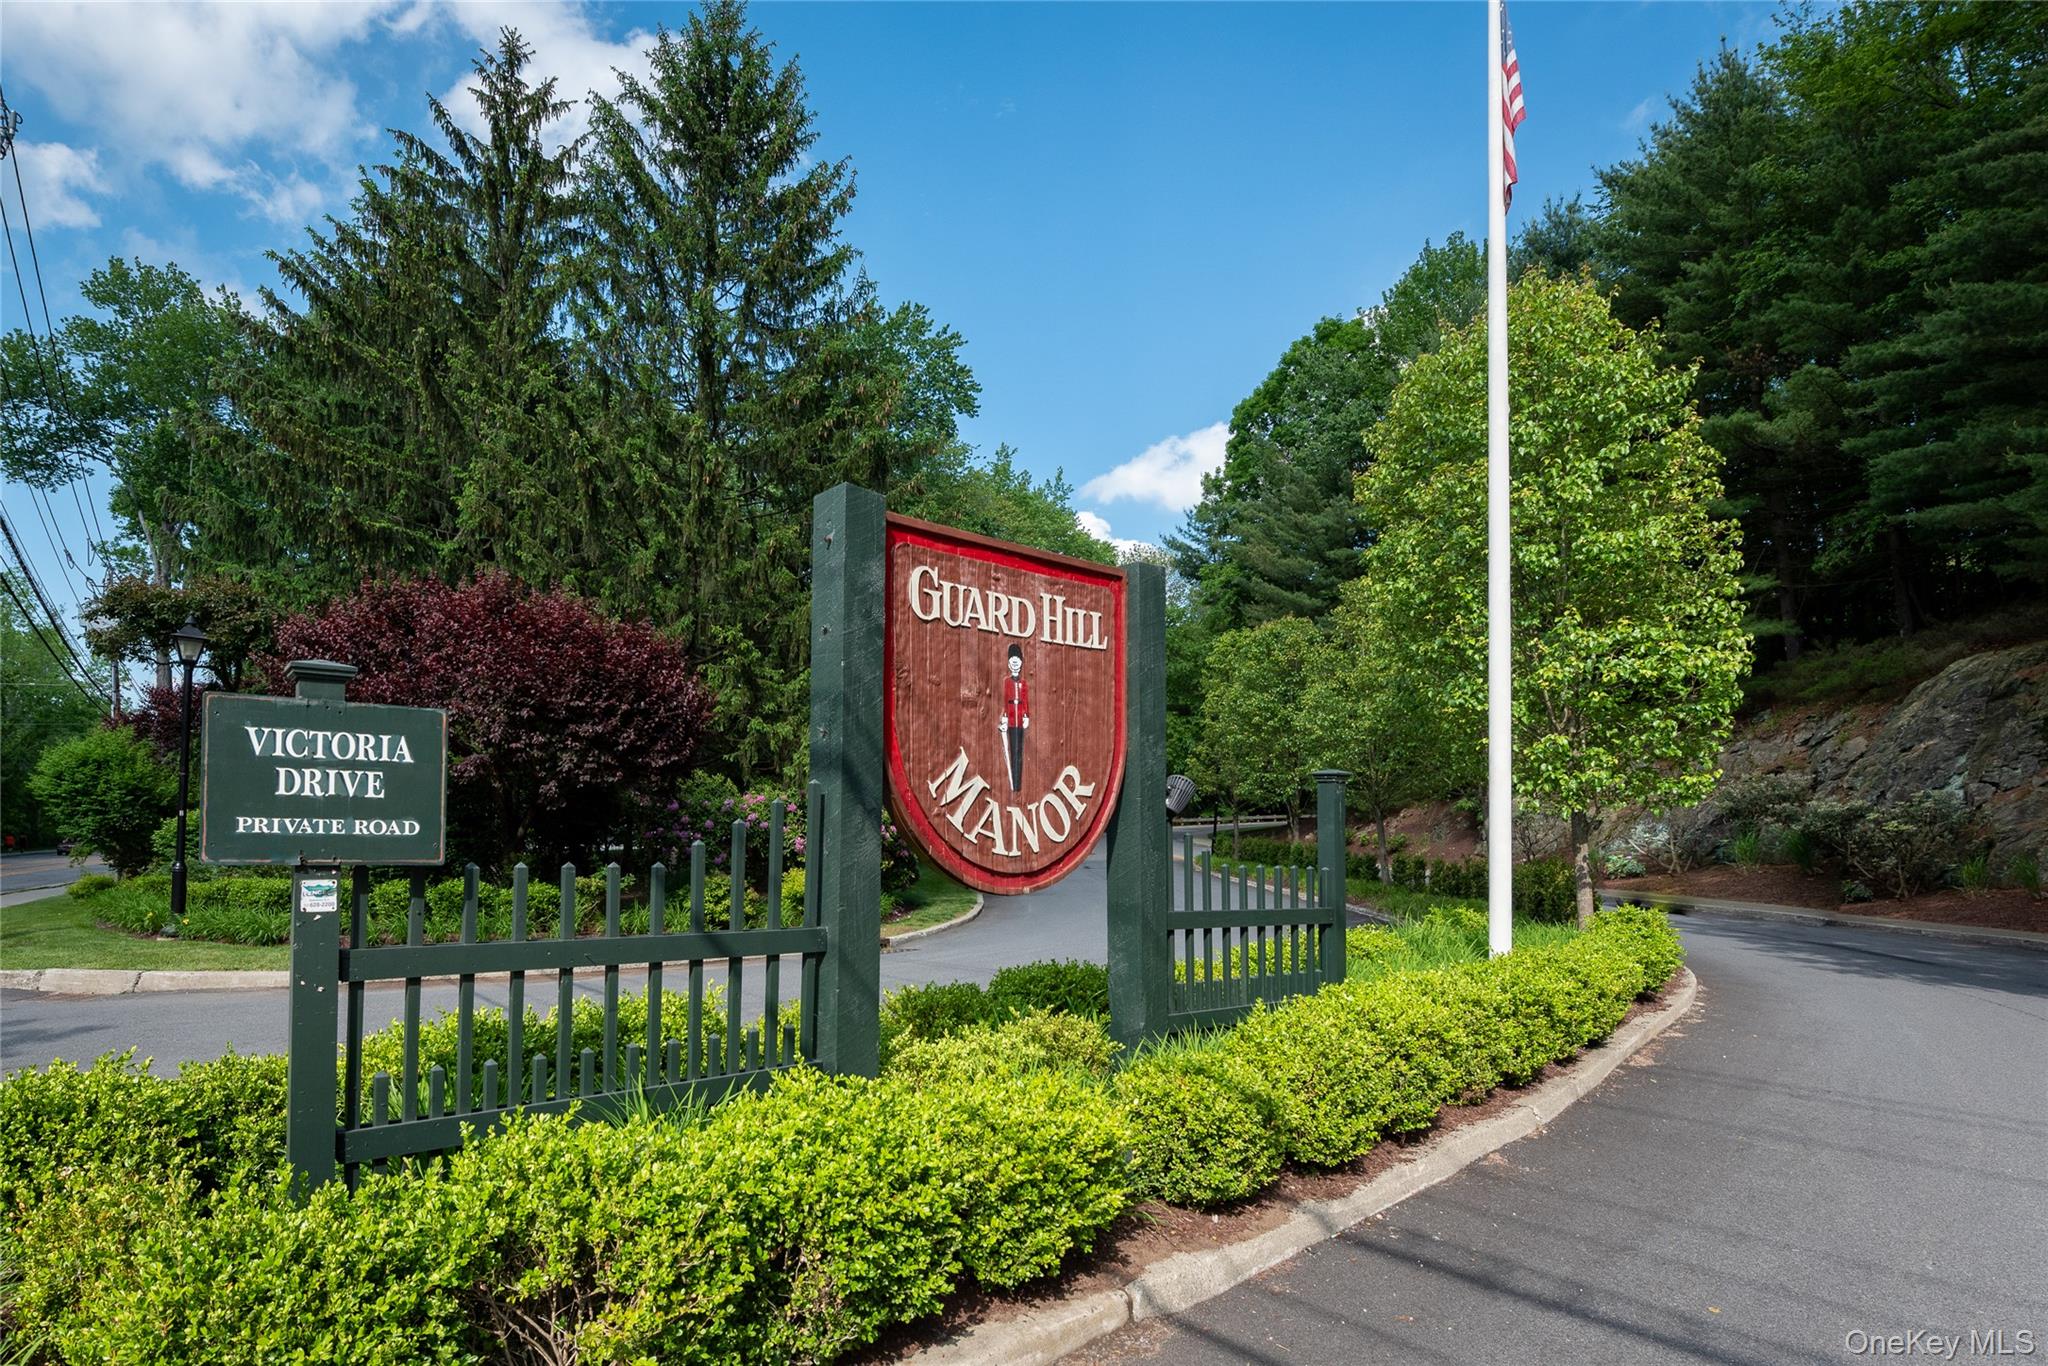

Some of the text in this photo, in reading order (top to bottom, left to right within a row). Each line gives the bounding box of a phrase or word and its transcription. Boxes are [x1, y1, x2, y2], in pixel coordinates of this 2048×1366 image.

[908, 565, 1108, 650] GUARD HILL
[245, 726, 414, 763] VICTORIA
[275, 767, 384, 799] DRIVE
[928, 746, 1095, 857] MANOR
[236, 816, 420, 836] PRIVATE ROAD
